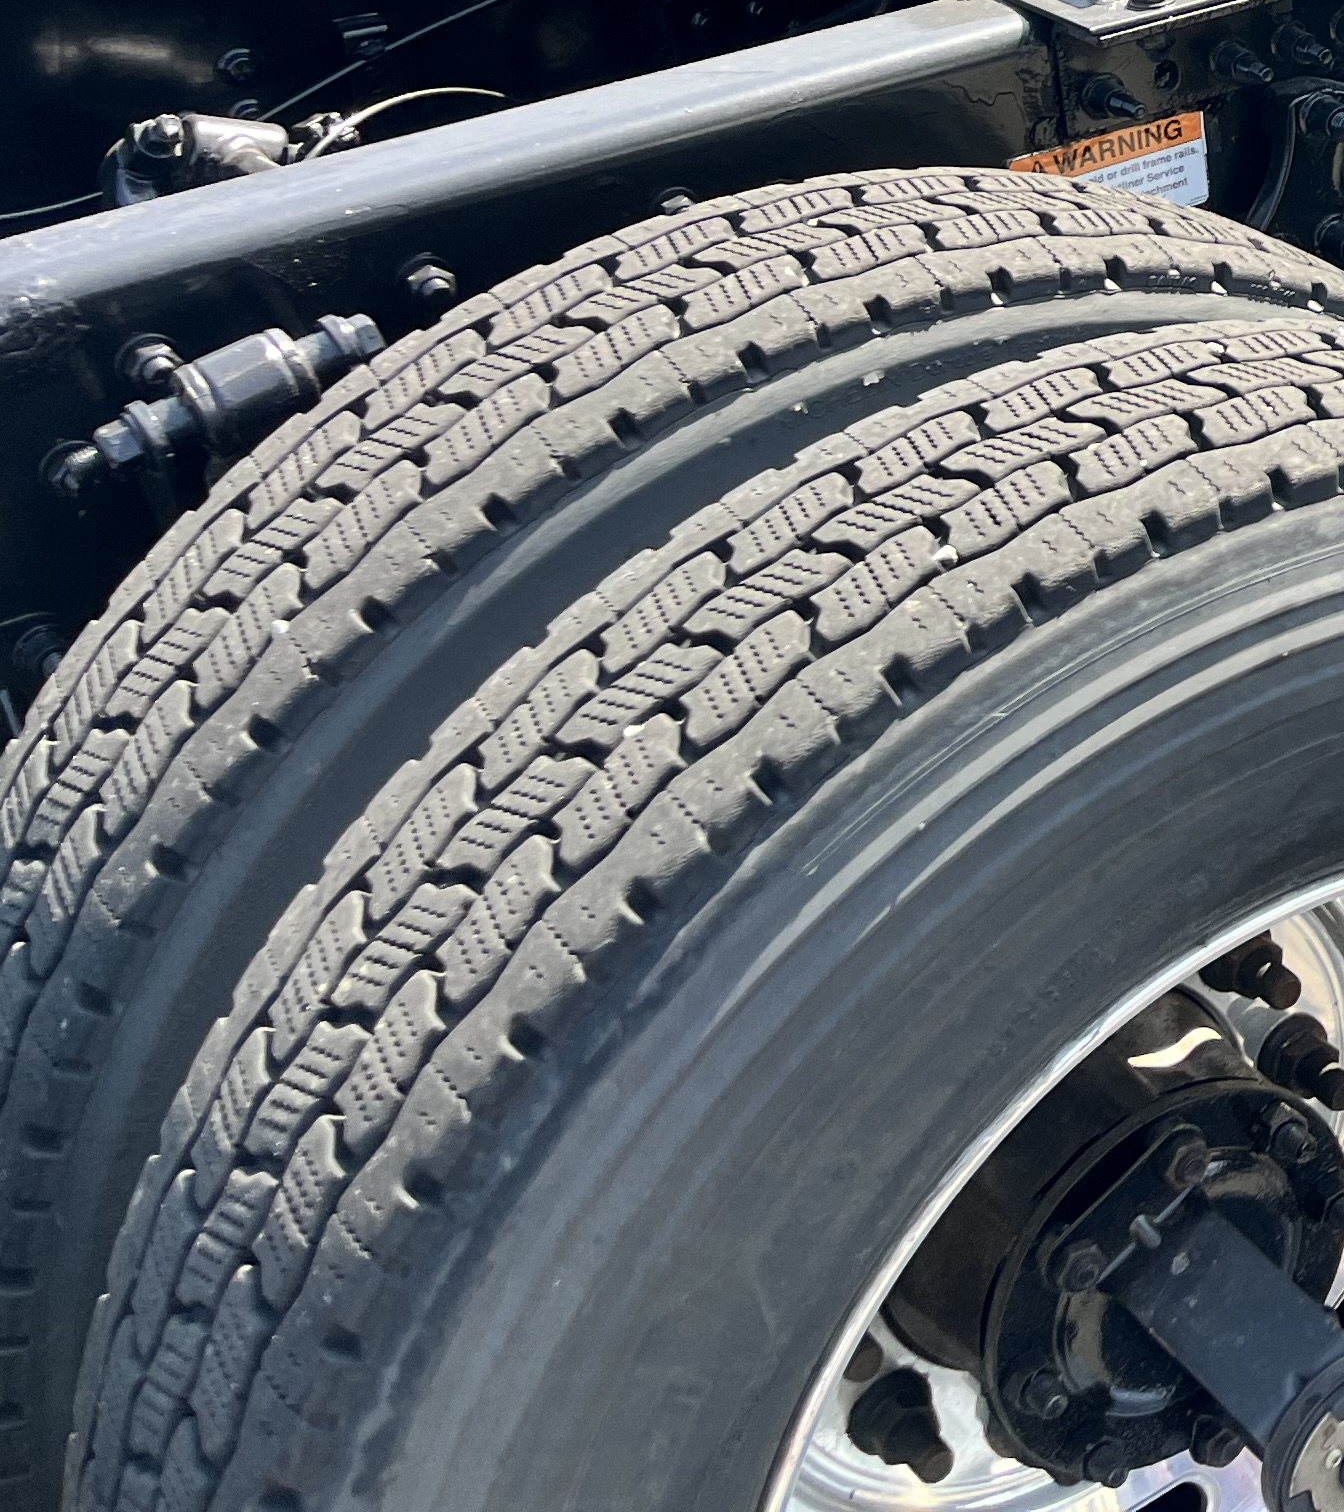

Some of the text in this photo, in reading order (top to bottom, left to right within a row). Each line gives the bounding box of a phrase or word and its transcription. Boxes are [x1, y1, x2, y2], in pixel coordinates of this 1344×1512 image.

[1053, 119, 1183, 174] WARNING
[1143, 155, 1172, 170] frame
[1174, 146, 1200, 160] rails.
[1147, 165, 1185, 182] Service
